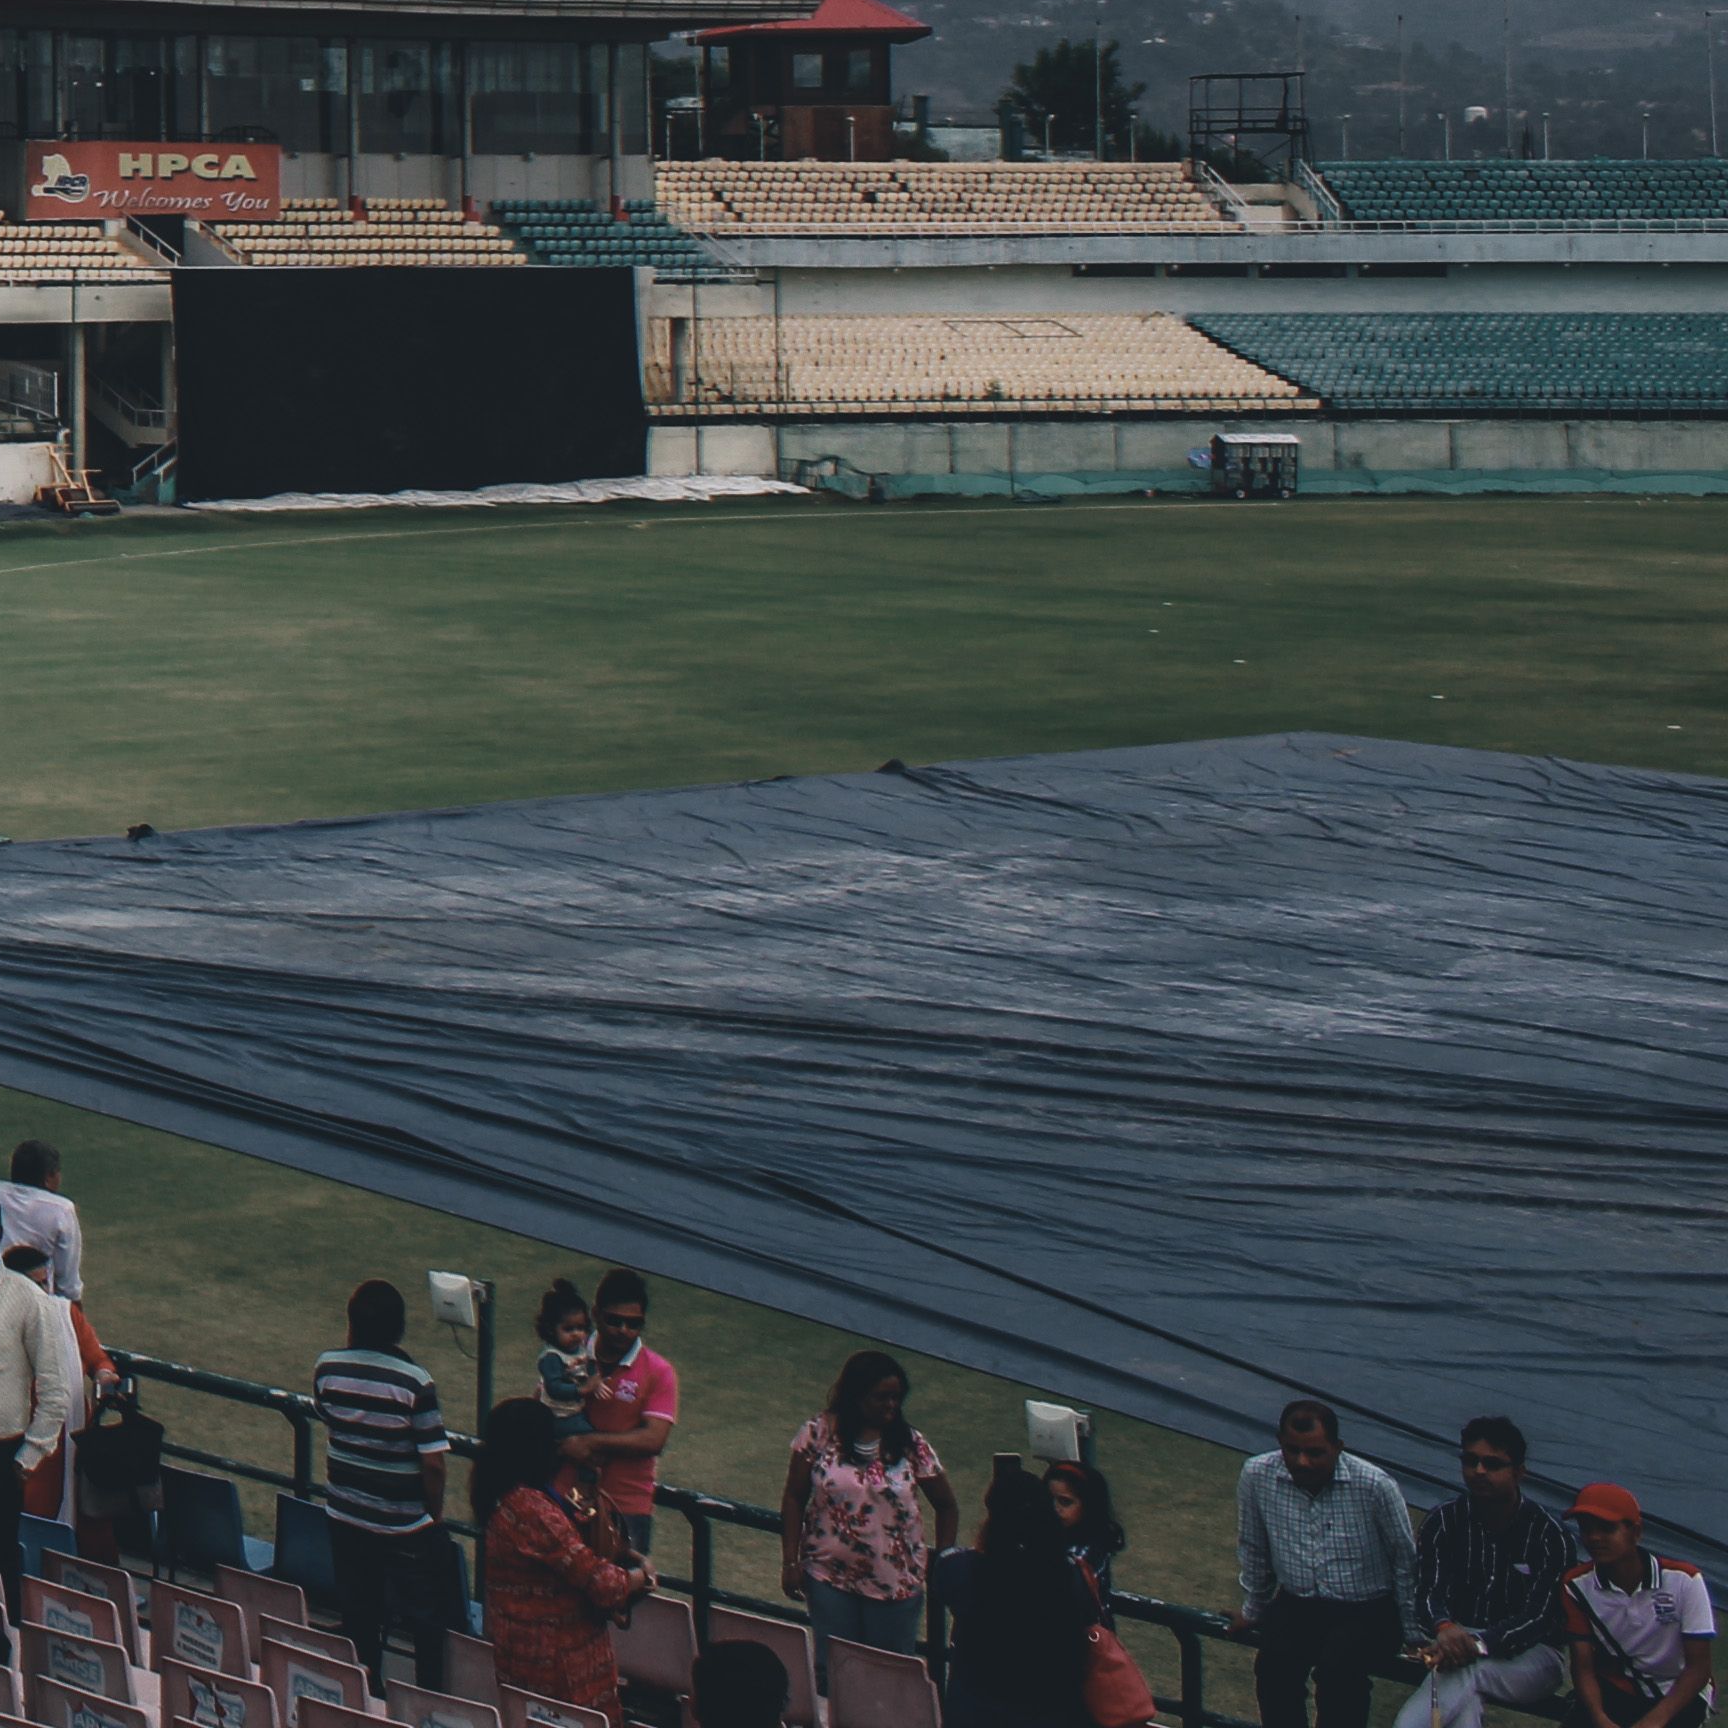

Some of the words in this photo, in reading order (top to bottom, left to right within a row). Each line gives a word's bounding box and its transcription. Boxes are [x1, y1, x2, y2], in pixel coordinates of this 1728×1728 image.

[119, 153, 256, 179] HPCA
[93, 187, 212, 210] Welcomes
[220, 191, 271, 212] You
